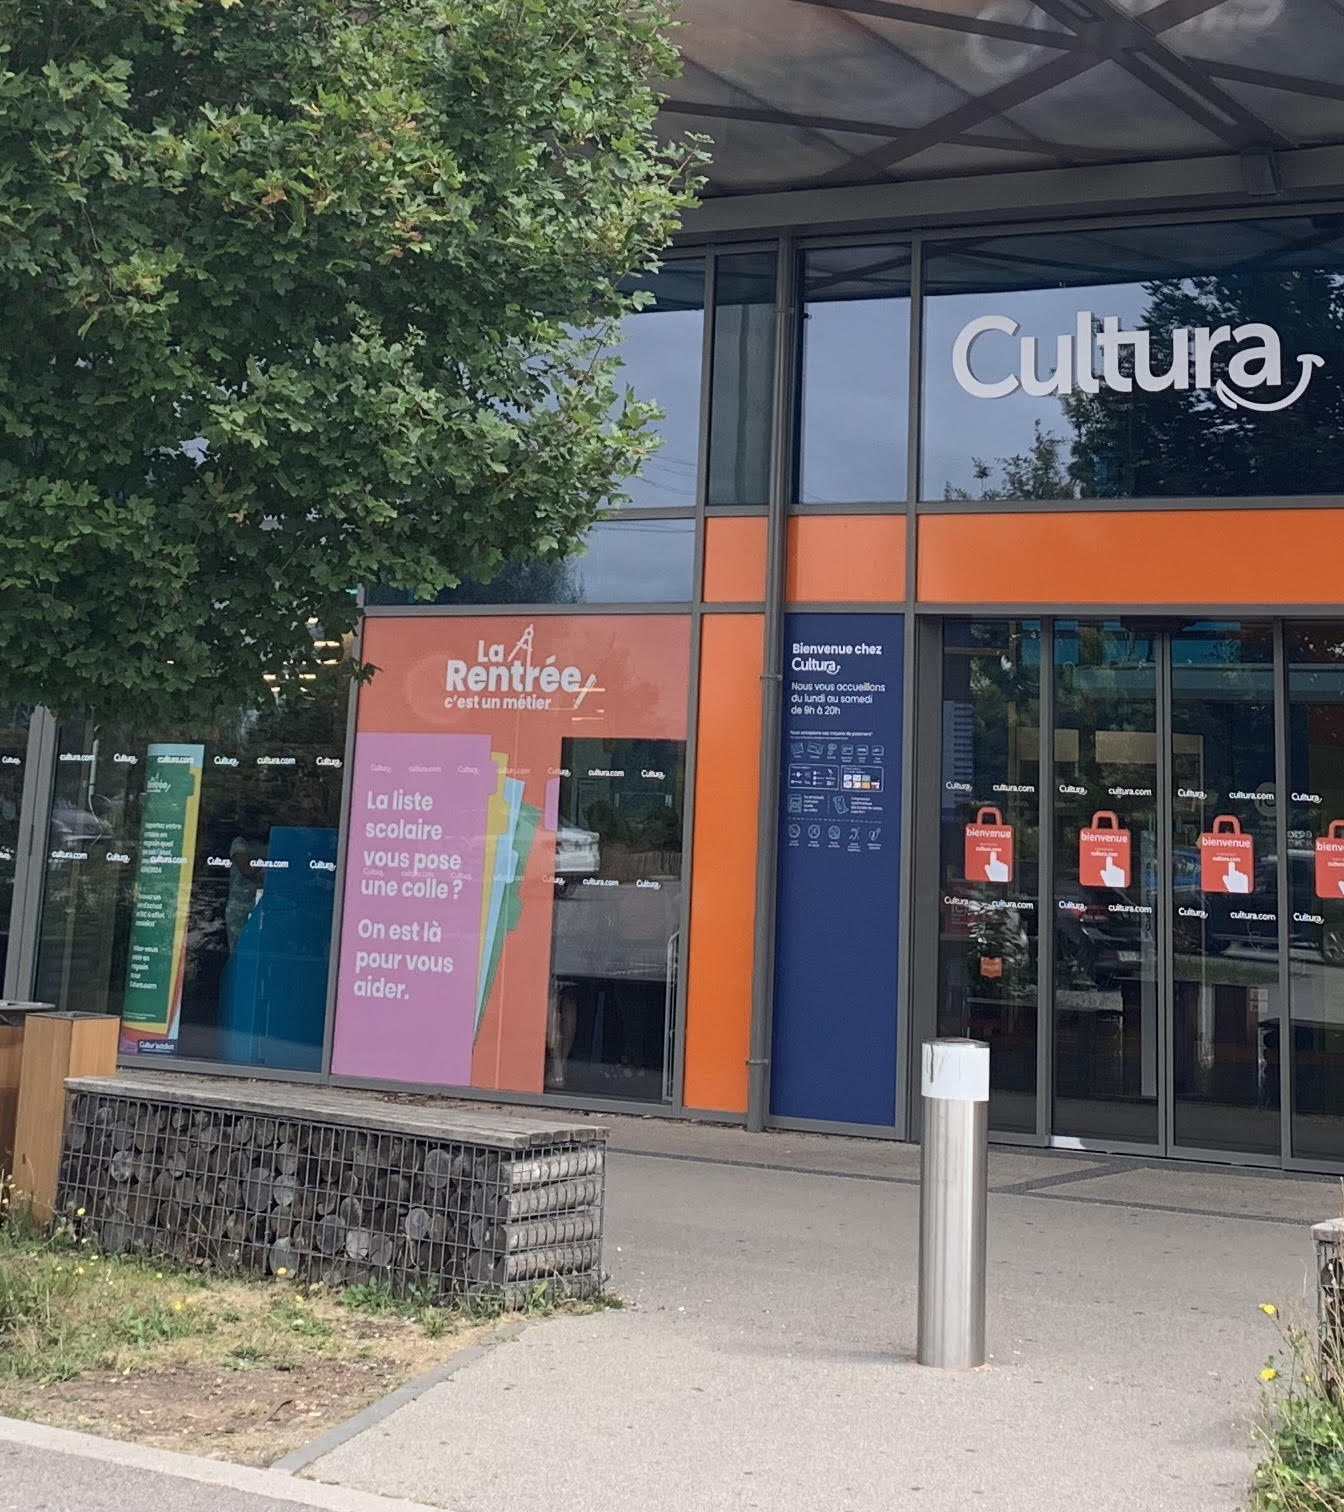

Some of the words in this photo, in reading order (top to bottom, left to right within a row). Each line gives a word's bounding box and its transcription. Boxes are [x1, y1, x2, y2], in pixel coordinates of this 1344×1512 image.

[952, 310, 1325, 411] Cultura
[477, 639, 504, 663] La
[792, 642, 853, 654] Bienvenue
[854, 643, 883, 655] chez
[791, 657, 841, 675] Cultura
[445, 655, 582, 693] Rentrée
[791, 682, 813, 691] Nous
[814, 683, 835, 691] vous
[444, 694, 479, 709] c'est
[482, 696, 500, 709] un
[503, 694, 552, 709] métier
[791, 694, 802, 702] du
[804, 694, 825, 703] lundi
[826, 695, 839, 703] au
[840, 695, 873, 703] samedi
[791, 706, 802, 715] de
[992, 784, 1035, 793] cultura.com
[1059, 784, 1088, 796] Cultura
[1108, 787, 1152, 796] cultura.com
[1177, 788, 1207, 800] Cultura
[1229, 791, 1274, 800] cultura.com
[367, 790, 388, 810] La
[392, 789, 433, 811] liste
[1291, 792, 1323, 804] Cultura
[365, 818, 443, 840] scolaire
[966, 827, 1012, 838] bienvenue
[1081, 831, 1128, 843] bienvenue
[1202, 836, 1251, 848] bienvenue
[363, 850, 410, 868] vous
[413, 852, 462, 876] pose
[361, 879, 398, 896] une
[402, 878, 449, 899] colle
[452, 879, 463, 899] ?
[1058, 900, 1088, 912] Cultura
[1108, 904, 1152, 914] cultura.com
[1178, 907, 1208, 919] Cultura
[1230, 910, 1276, 921] cultura.com
[1293, 912, 1325, 924] Cultura
[358, 918, 385, 939] On
[389, 921, 419, 942] est
[423, 920, 442, 943] là
[355, 951, 403, 974] pour
[405, 954, 454, 973] vous
[353, 975, 409, 1000] aider.
